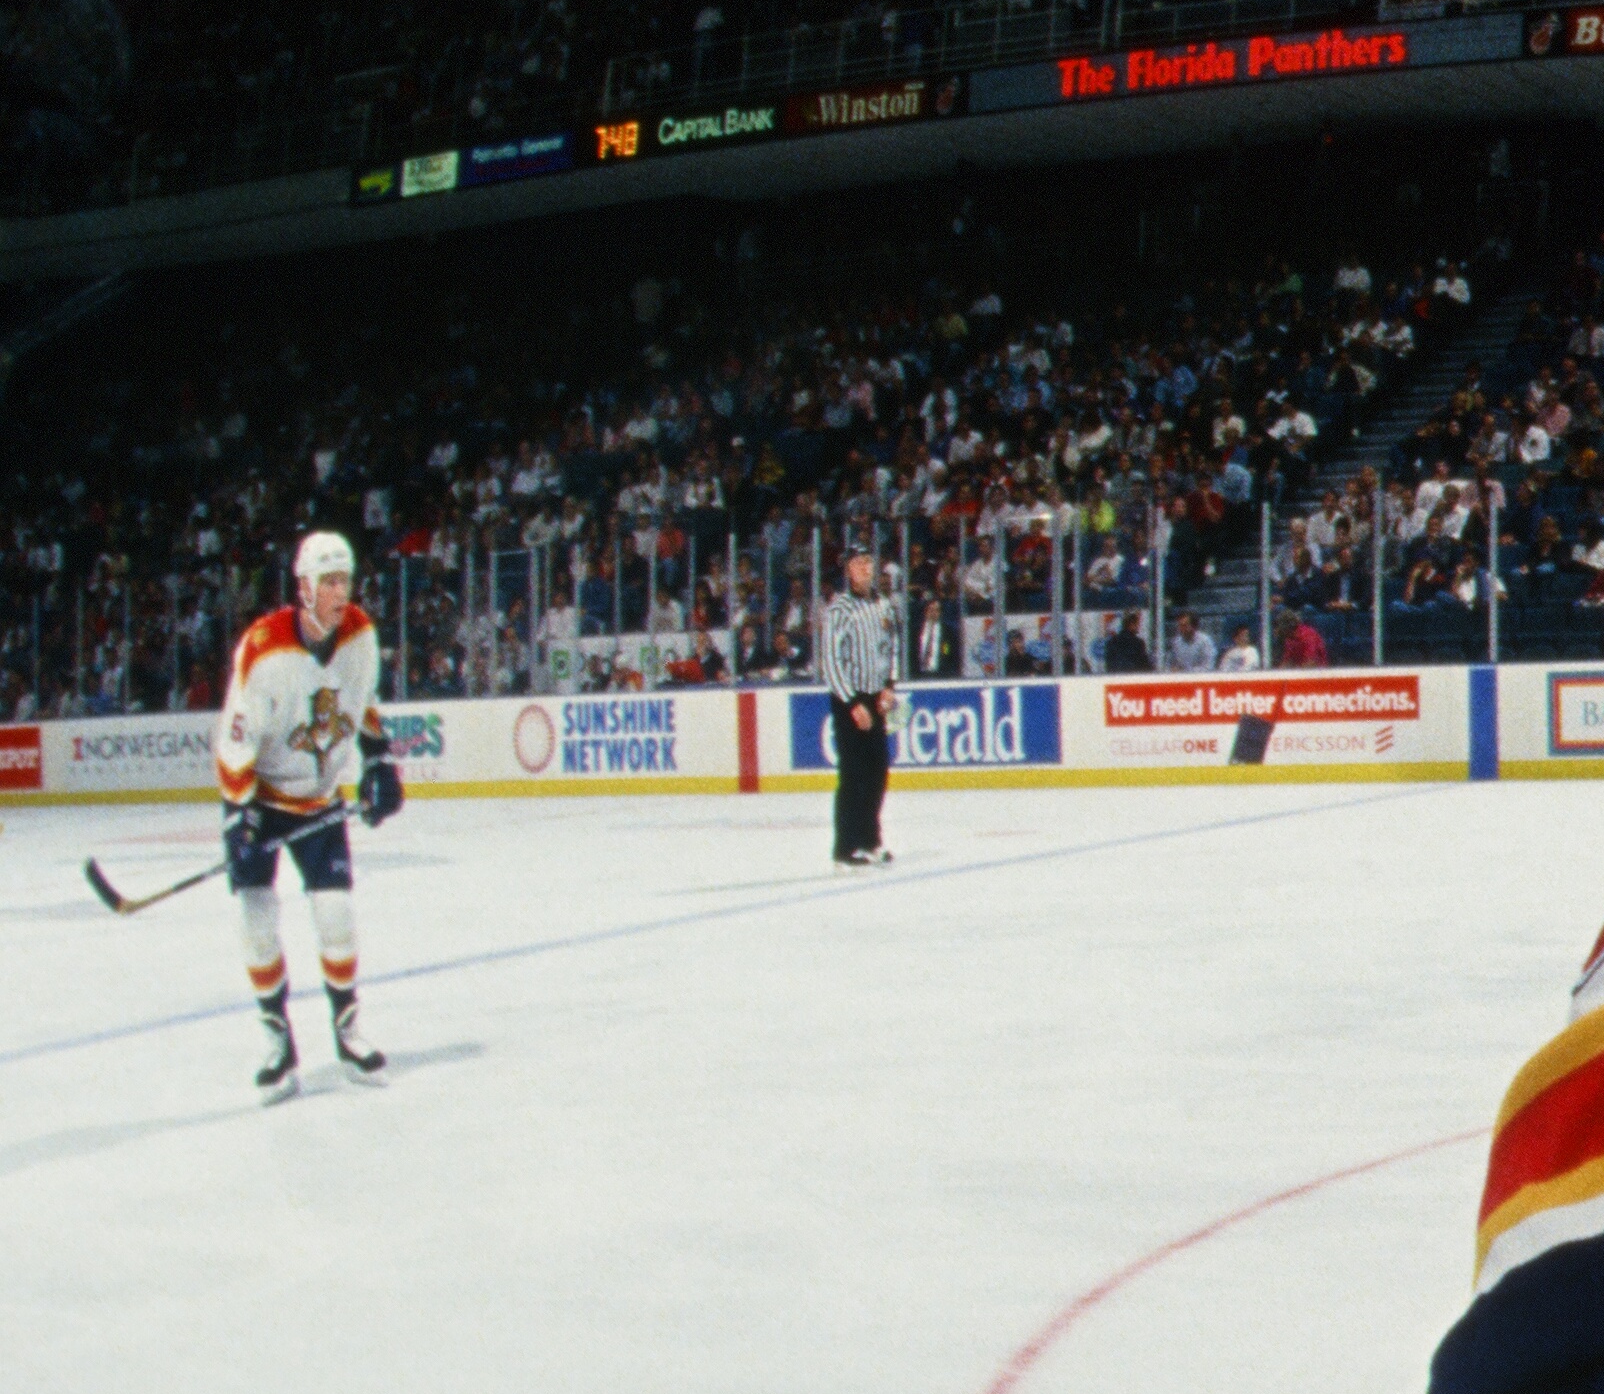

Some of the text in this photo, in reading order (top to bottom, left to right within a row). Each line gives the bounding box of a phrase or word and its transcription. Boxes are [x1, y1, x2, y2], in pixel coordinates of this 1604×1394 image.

[1057, 28, 1406, 99] The Florida Panthers
[817, 90, 919, 126] Winston
[562, 699, 676, 737] SUNSHINE
[1107, 686, 1416, 718] You need better connections.
[562, 737, 677, 772] NETWORK
[1271, 734, 1368, 753] ERICSSON
